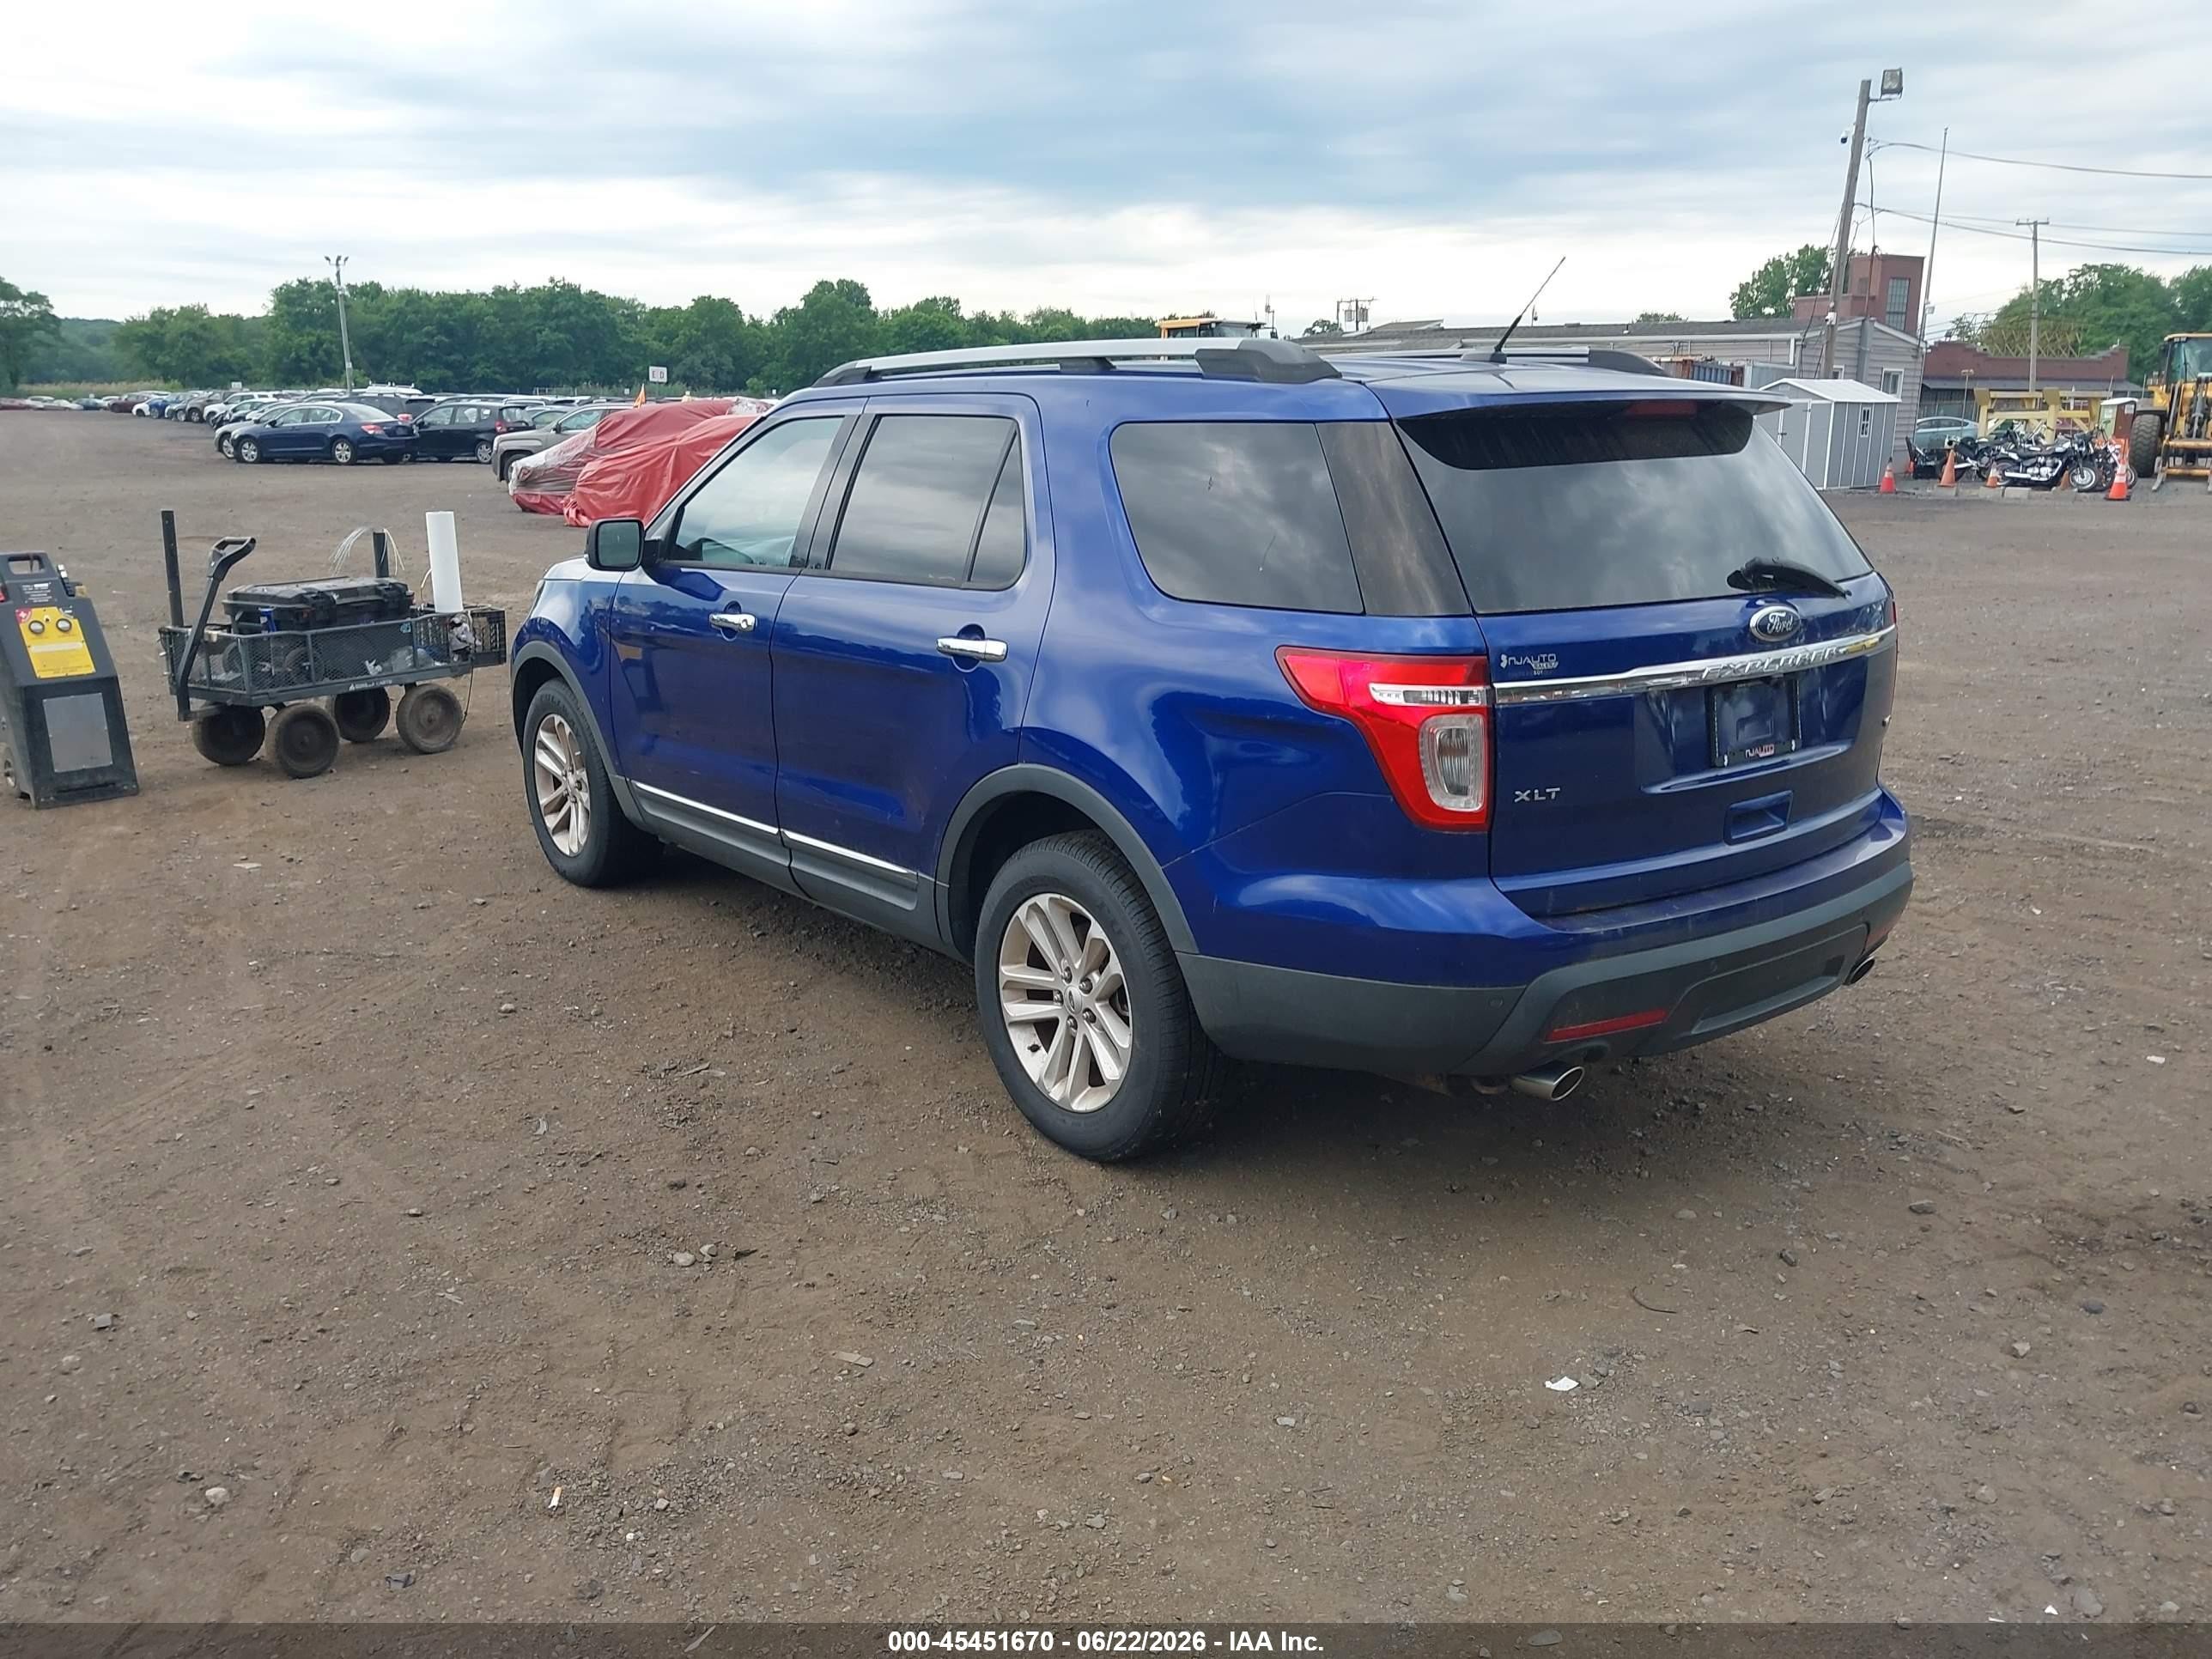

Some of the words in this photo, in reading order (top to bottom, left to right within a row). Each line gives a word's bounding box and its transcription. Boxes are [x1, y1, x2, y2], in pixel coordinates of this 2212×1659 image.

[1766, 611, 1793, 634] Ford
[1700, 646, 1844, 680] EXPLORER
[1514, 787, 1560, 803] XLT
